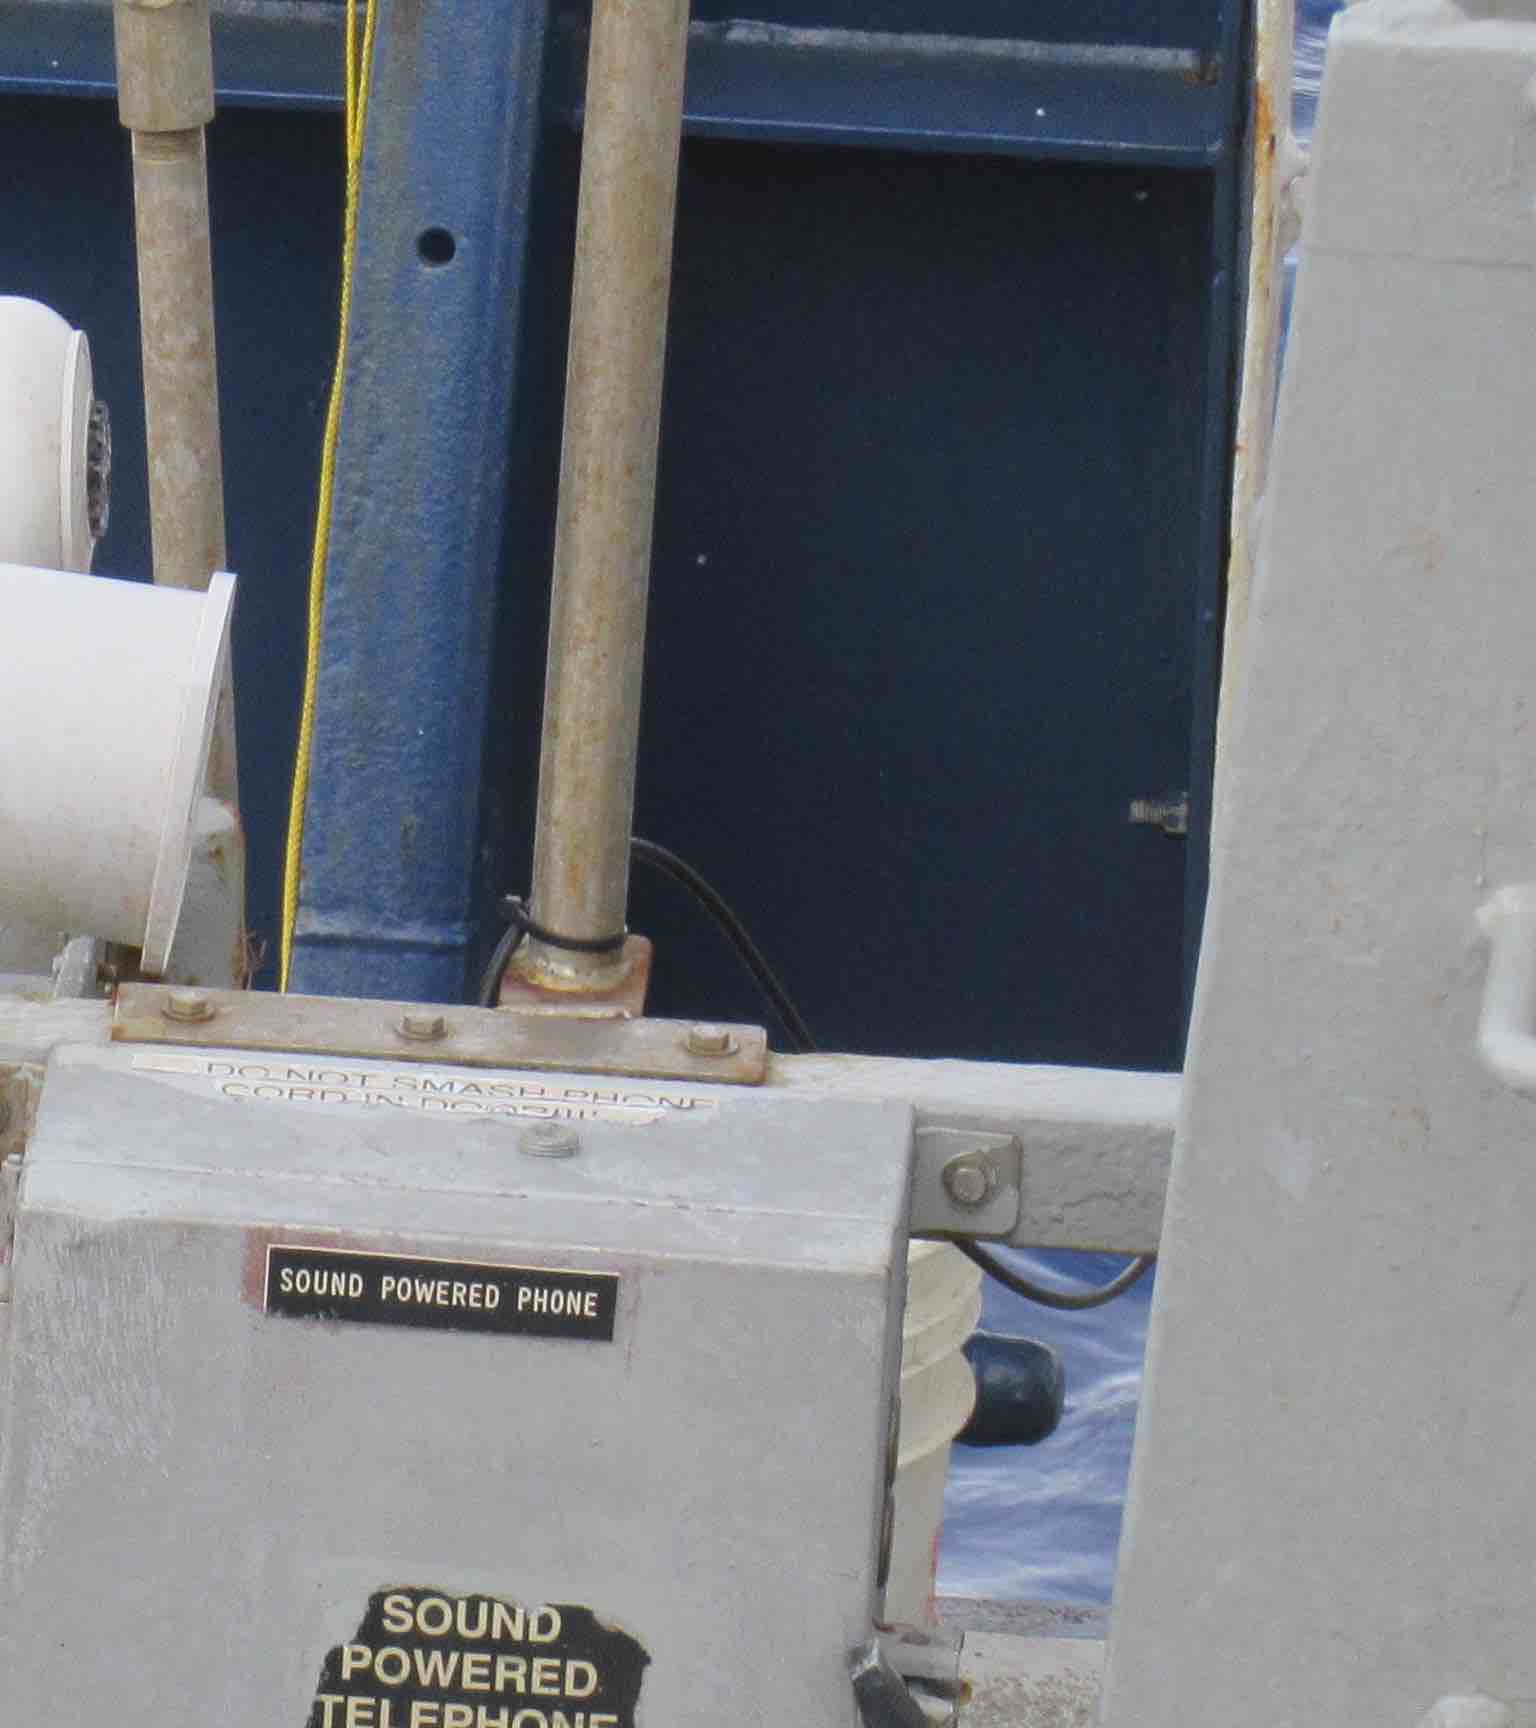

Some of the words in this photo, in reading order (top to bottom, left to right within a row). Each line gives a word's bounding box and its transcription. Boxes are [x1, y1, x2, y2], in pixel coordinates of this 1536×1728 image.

[208, 1061, 270, 1081] DO
[286, 1068, 371, 1088] NOT
[392, 1073, 546, 1099] SMASH
[563, 1088, 715, 1111] PHONE
[221, 1081, 347, 1104] CORD
[361, 1090, 403, 1107] IN
[279, 1266, 364, 1298] SOUND
[381, 1275, 500, 1310] POWERED
[517, 1286, 599, 1317] PHONE
[381, 1594, 563, 1645] SOUND
[340, 1645, 599, 1699] POWERED
